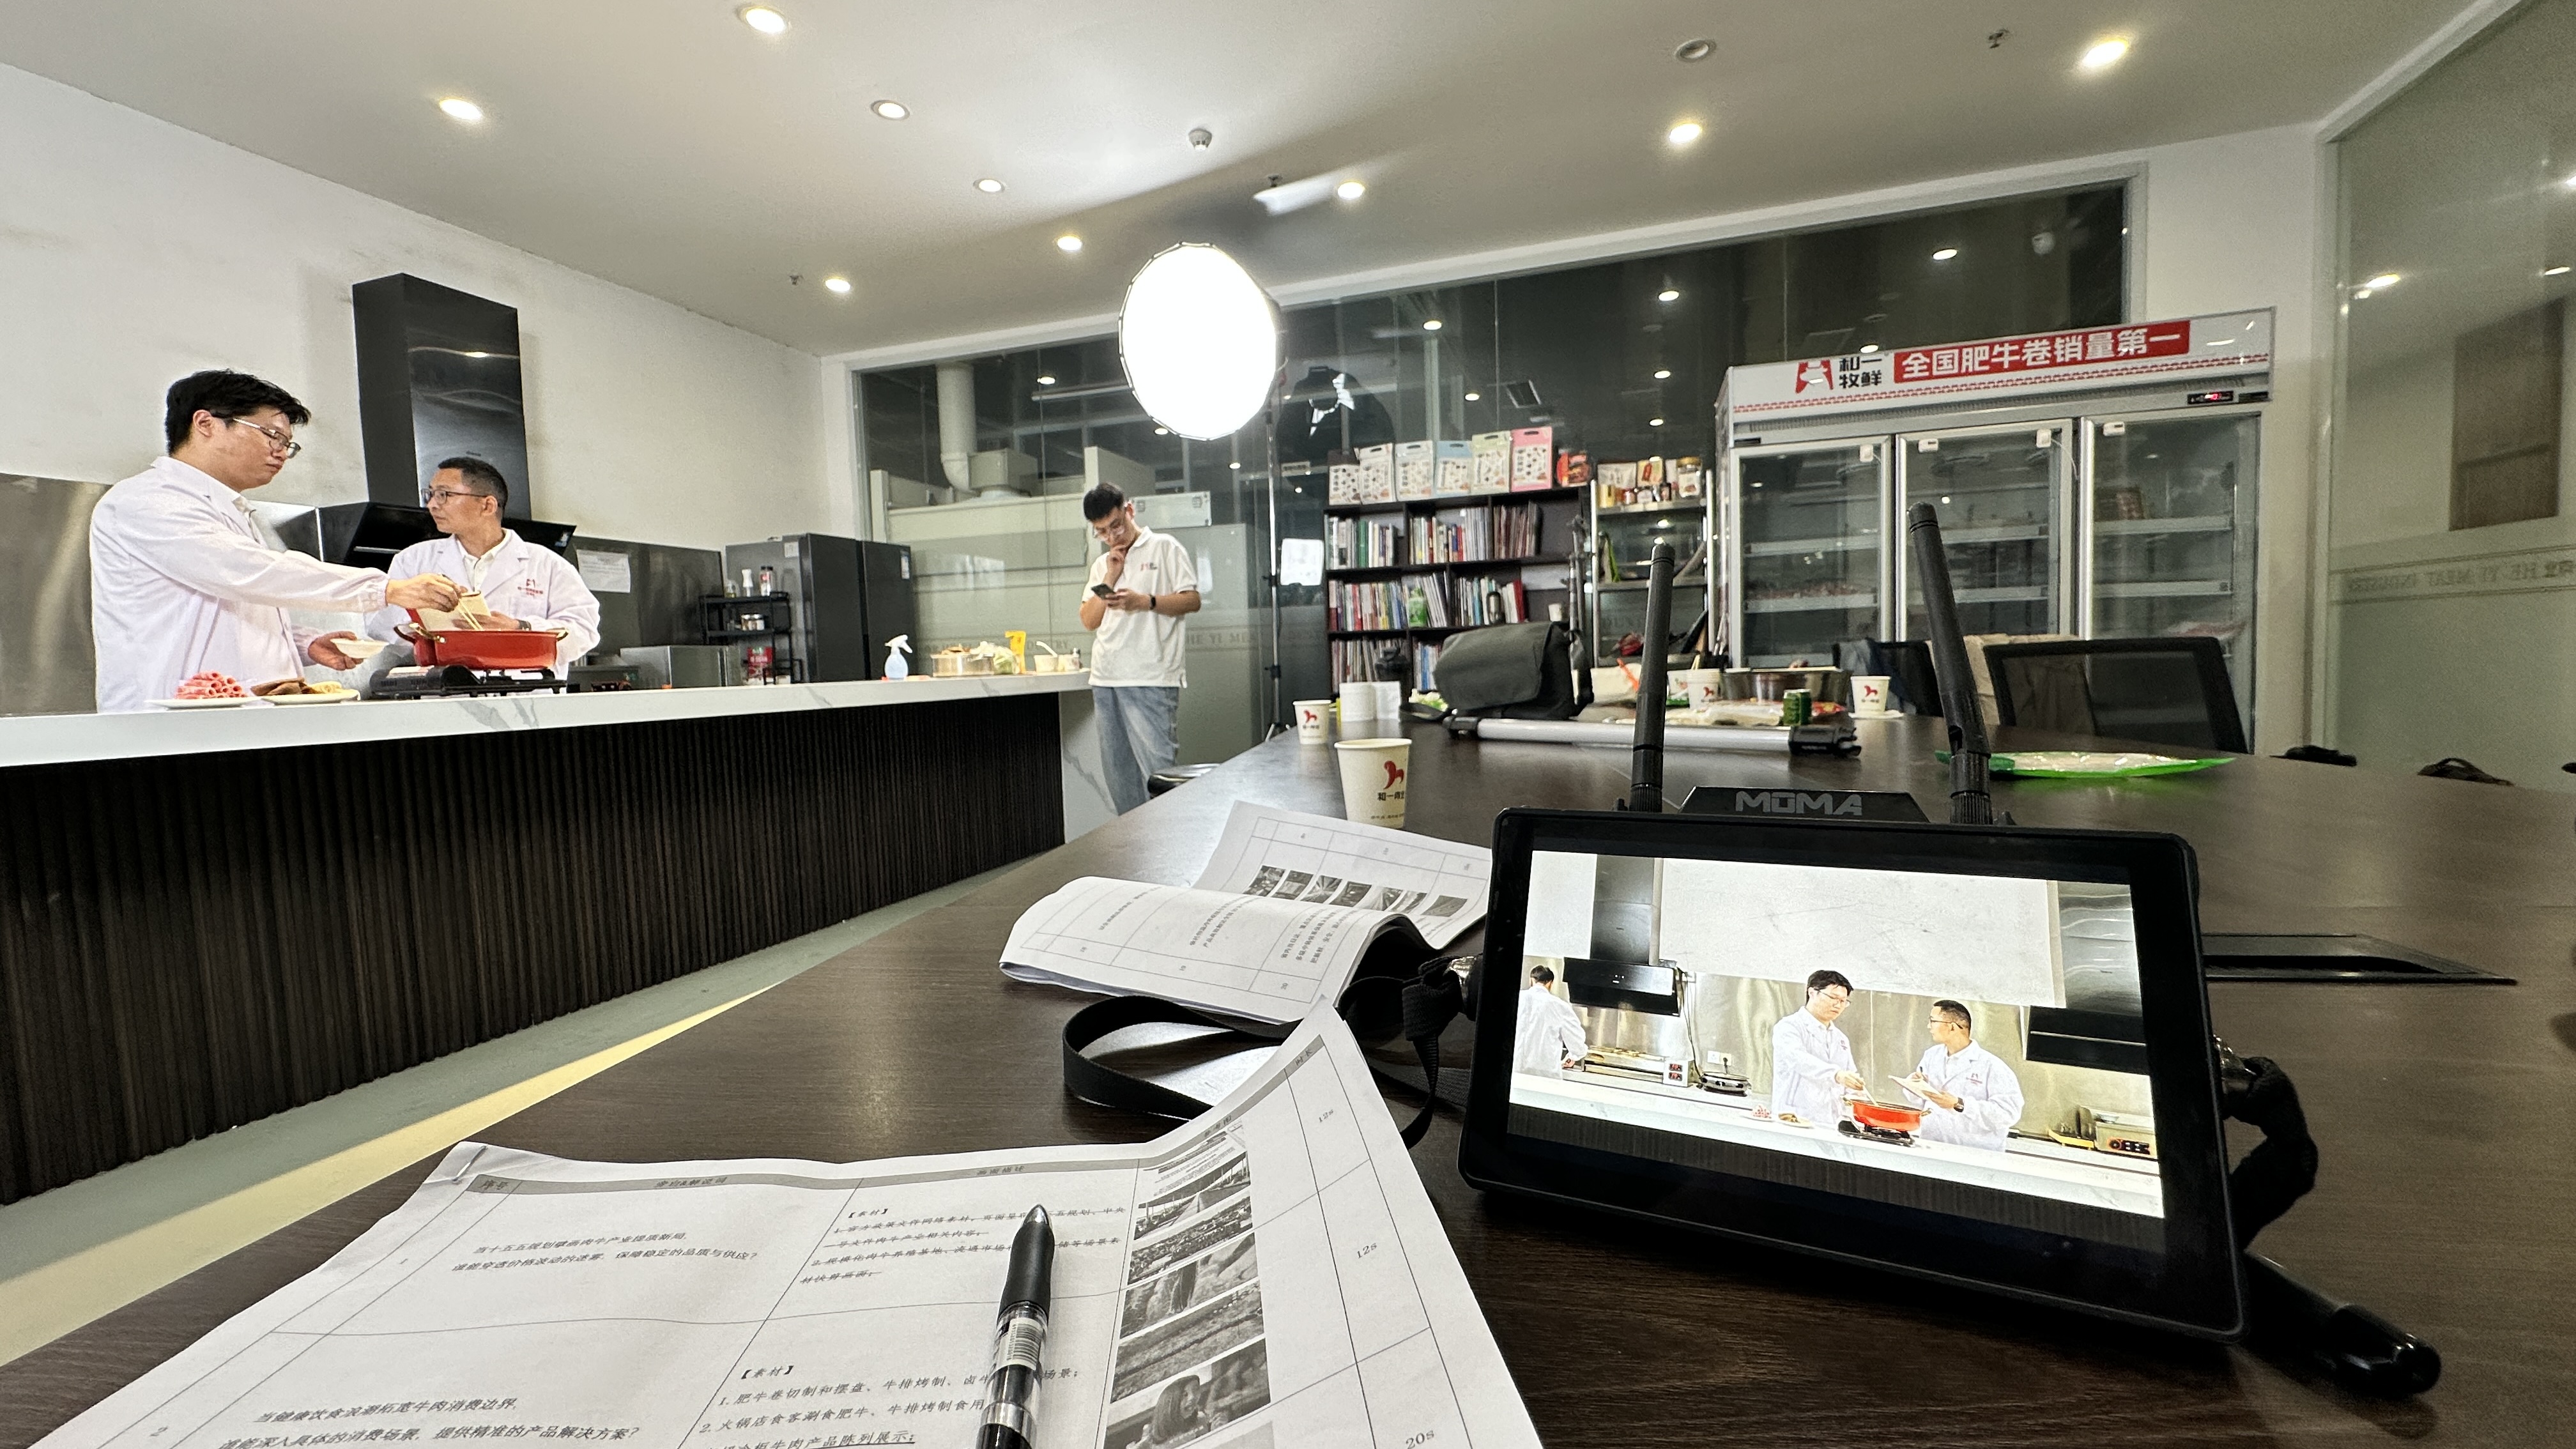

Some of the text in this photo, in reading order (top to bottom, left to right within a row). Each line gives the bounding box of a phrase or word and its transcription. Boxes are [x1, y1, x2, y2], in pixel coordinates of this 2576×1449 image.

[1902, 328, 2180, 378] 全国肥牛卷销量第一
[1839, 369, 1882, 388] 牧鲜
[1735, 790, 1862, 815] MOMA
[1356, 1243, 1377, 1259] 12s
[741, 1365, 794, 1380] 【素材】
[1406, 1430, 1434, 1449] 20s
